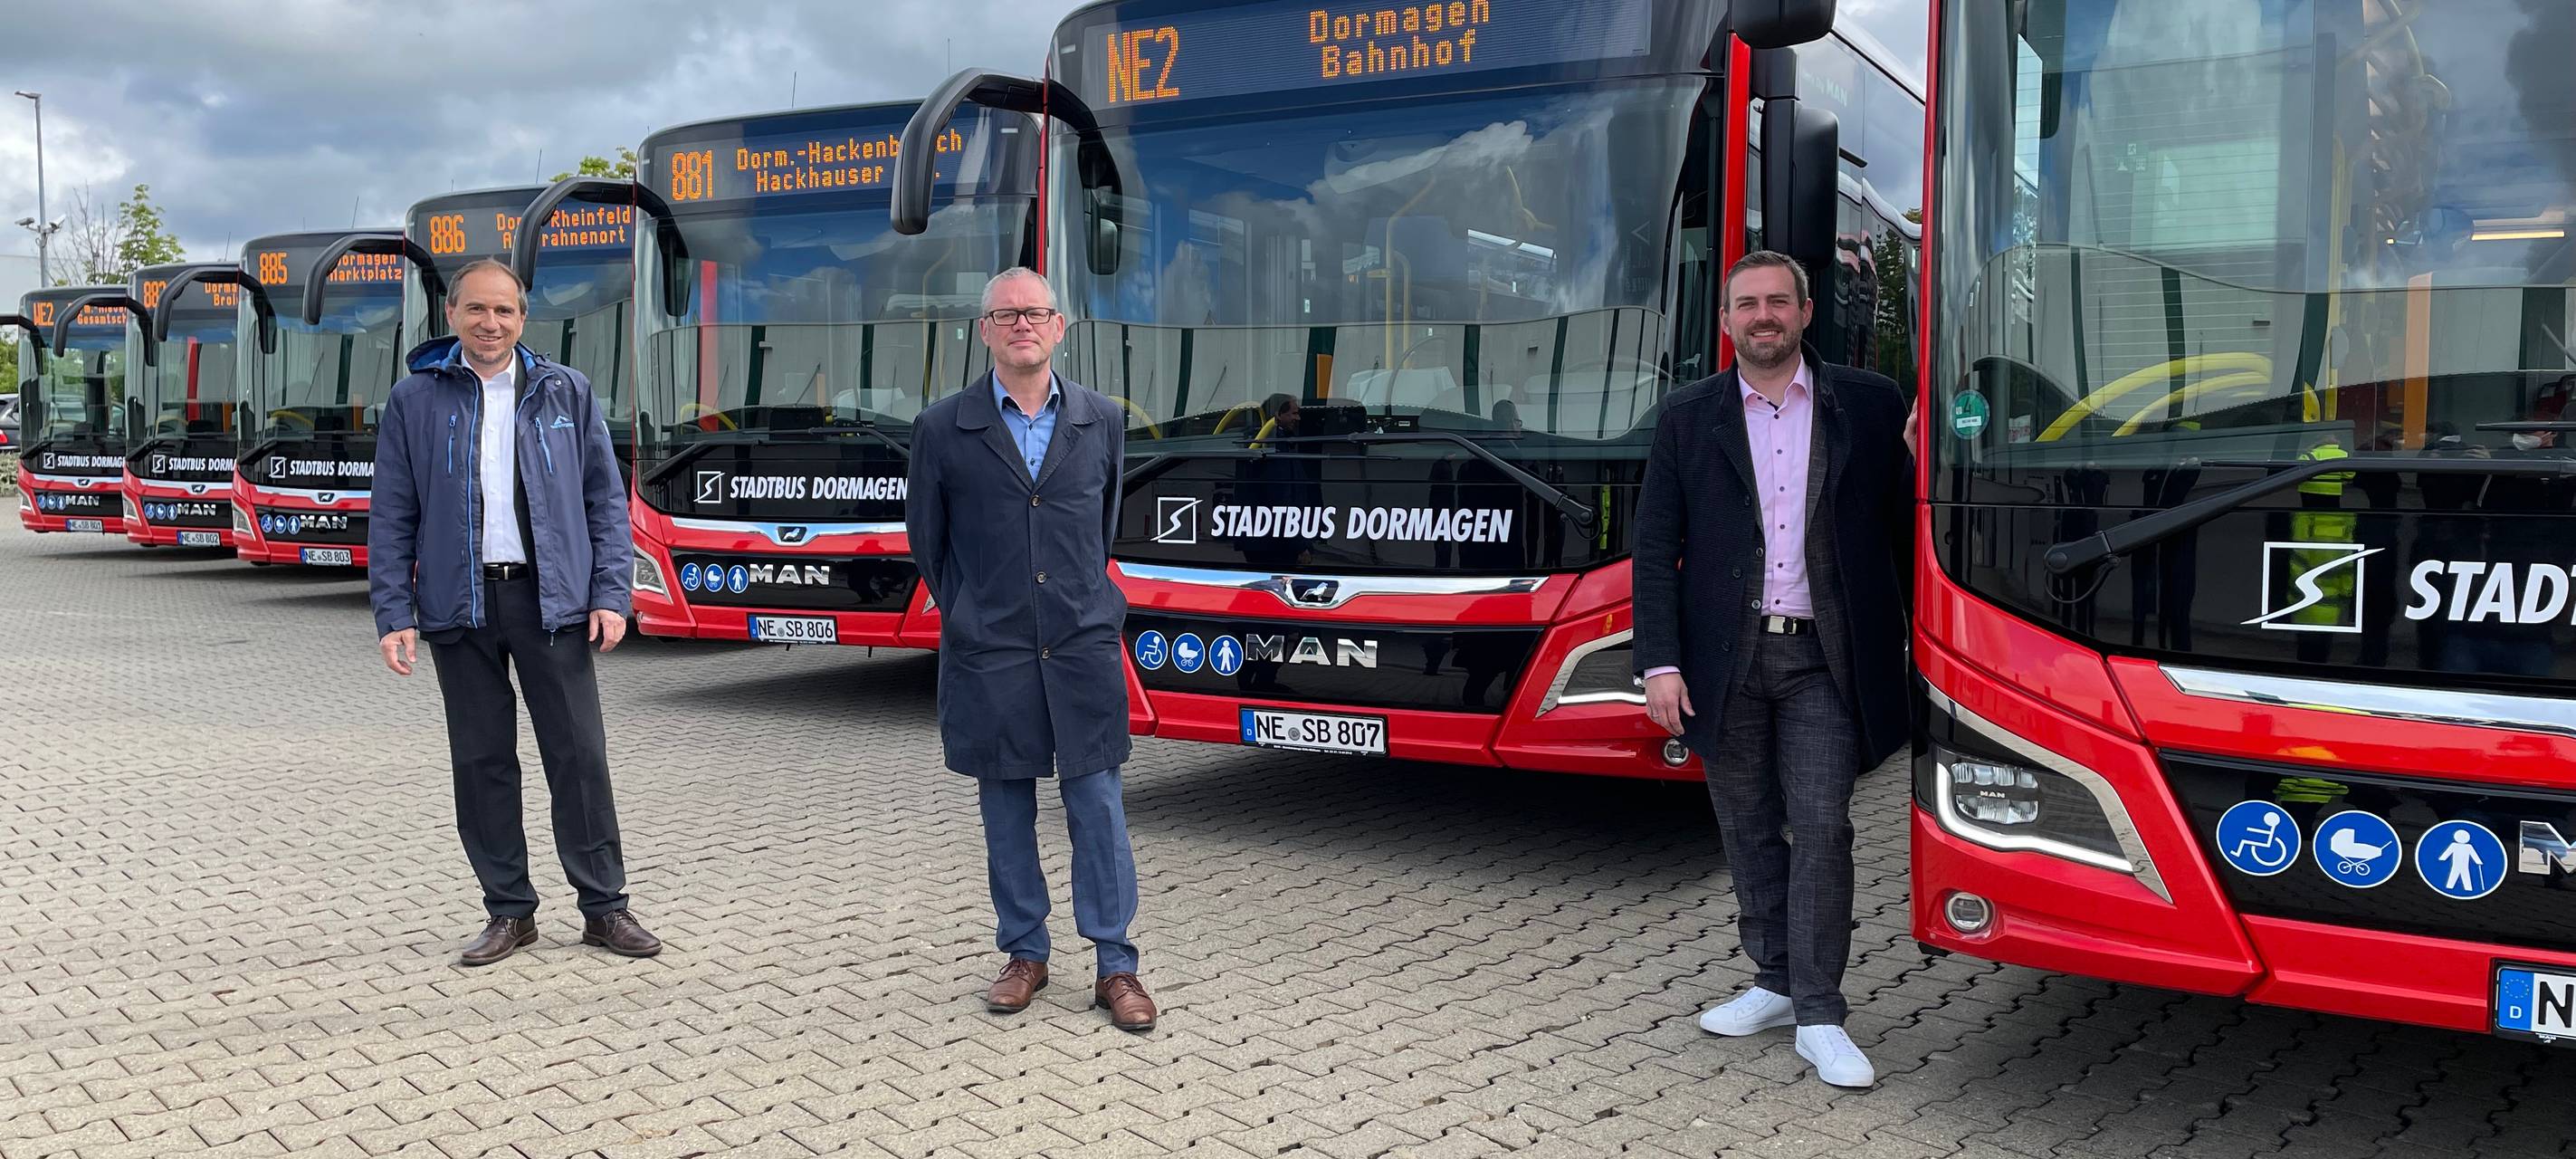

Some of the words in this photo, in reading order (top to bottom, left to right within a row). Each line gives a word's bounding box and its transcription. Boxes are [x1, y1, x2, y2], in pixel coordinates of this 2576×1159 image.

[1310, 0, 1490, 43] Dormagen
[1107, 26, 1178, 102] NE2
[1321, 28, 1475, 78] Bahnhof
[737, 129, 962, 170] Dorm.-Hackenbch
[672, 148, 713, 201] 881
[756, 165, 884, 193] Hackhauser
[430, 214, 465, 254] 886
[540, 225, 626, 248] rahnenort
[259, 253, 288, 284] 885
[329, 265, 403, 282] Marktplatz
[58, 455, 90, 467] STADTBUS
[168, 457, 206, 471] STADTBUS
[290, 460, 335, 476] STADTBUS
[66, 495, 100, 505] MAN
[730, 476, 806, 500] STADTBUS
[812, 476, 908, 500] DORMAGEN
[177, 503, 216, 516] MAN
[301, 514, 348, 529] MAN
[1211, 505, 1336, 539] STADTBUS
[1347, 507, 1513, 542] DORMAGEN
[322, 551, 332, 562] SB
[334, 551, 350, 562] 803
[749, 563, 830, 585] MAN
[2404, 560, 2576, 625] STAD
[758, 619, 777, 637] NE
[786, 620, 804, 637] SB
[807, 621, 833, 638] 806
[1245, 634, 1378, 668] MAN
[1246, 728, 1253, 736] D
[1255, 714, 1286, 741] NE
[1302, 718, 1331, 743] SB
[1338, 721, 1380, 748] 807
[1980, 790, 2006, 799] MAN
[2510, 1005, 2523, 1019] D
[2538, 981, 2574, 1029] N
